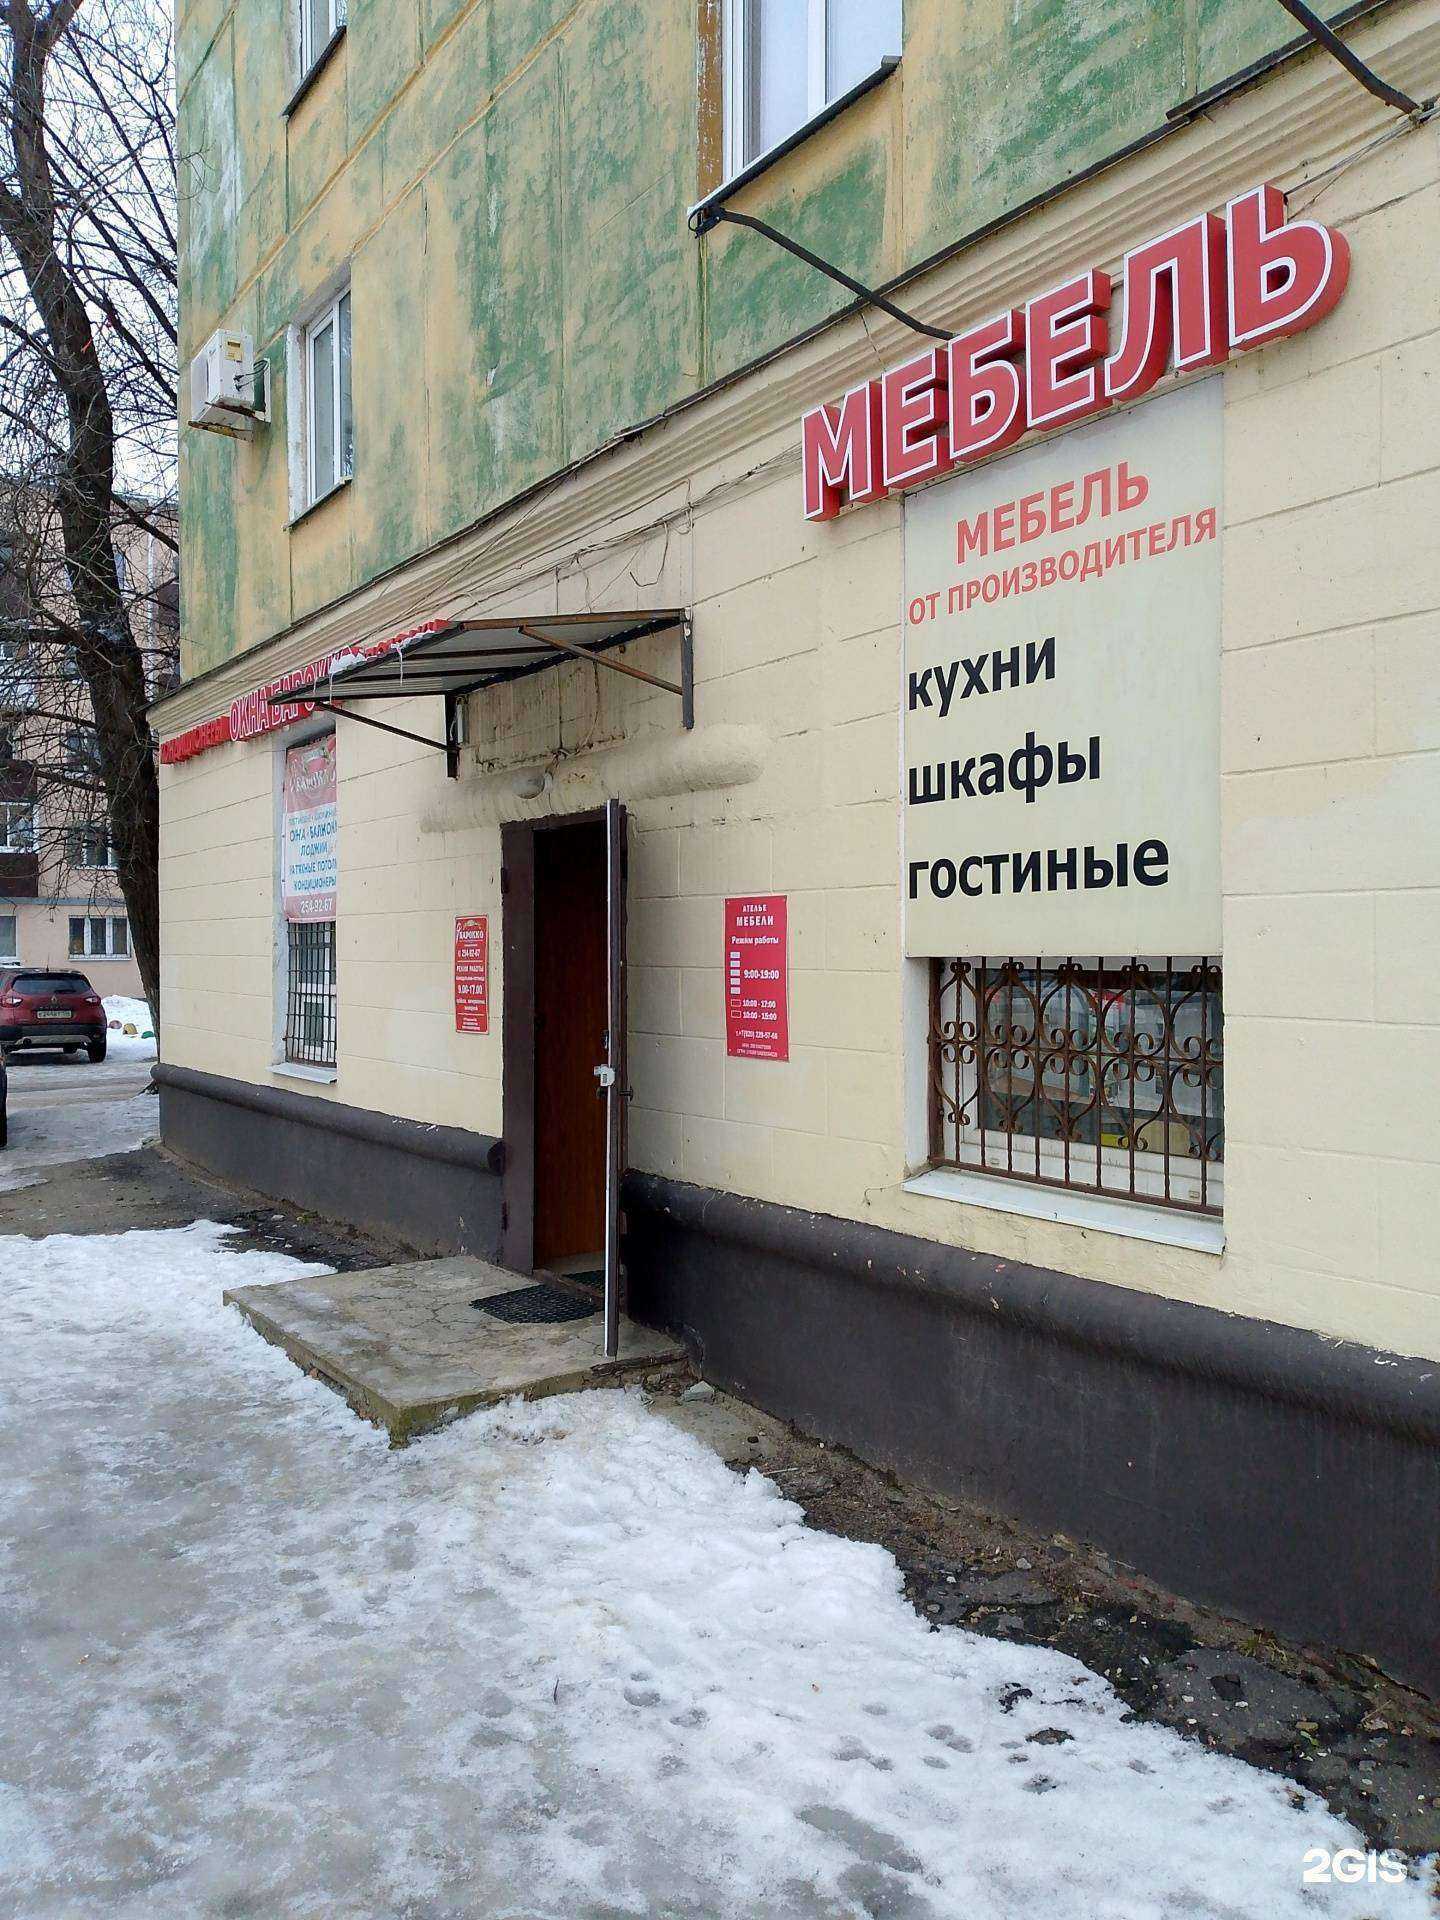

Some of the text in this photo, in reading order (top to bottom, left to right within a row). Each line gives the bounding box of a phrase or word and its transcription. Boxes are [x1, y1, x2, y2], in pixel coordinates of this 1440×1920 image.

[802, 183, 1348, 521] МЕБЕЛЬ
[957, 461, 1150, 564] МЕБЕЛЬ
[908, 507, 1217, 625] ОТ ПРОИЗВОДИТЕЛЯ
[908, 637, 1056, 718] кухни
[230, 685, 269, 741] ОКНА
[908, 731, 1101, 806] шкафы
[908, 838, 1169, 899] гостиные
[301, 899, 332, 914] 254-92-67
[736, 916, 774, 926] МЕБЕЛИ
[743, 904, 767, 913] АТЕЛЬЕ
[754, 936, 779, 946] работы
[744, 970, 779, 979] 9:00-19:00
